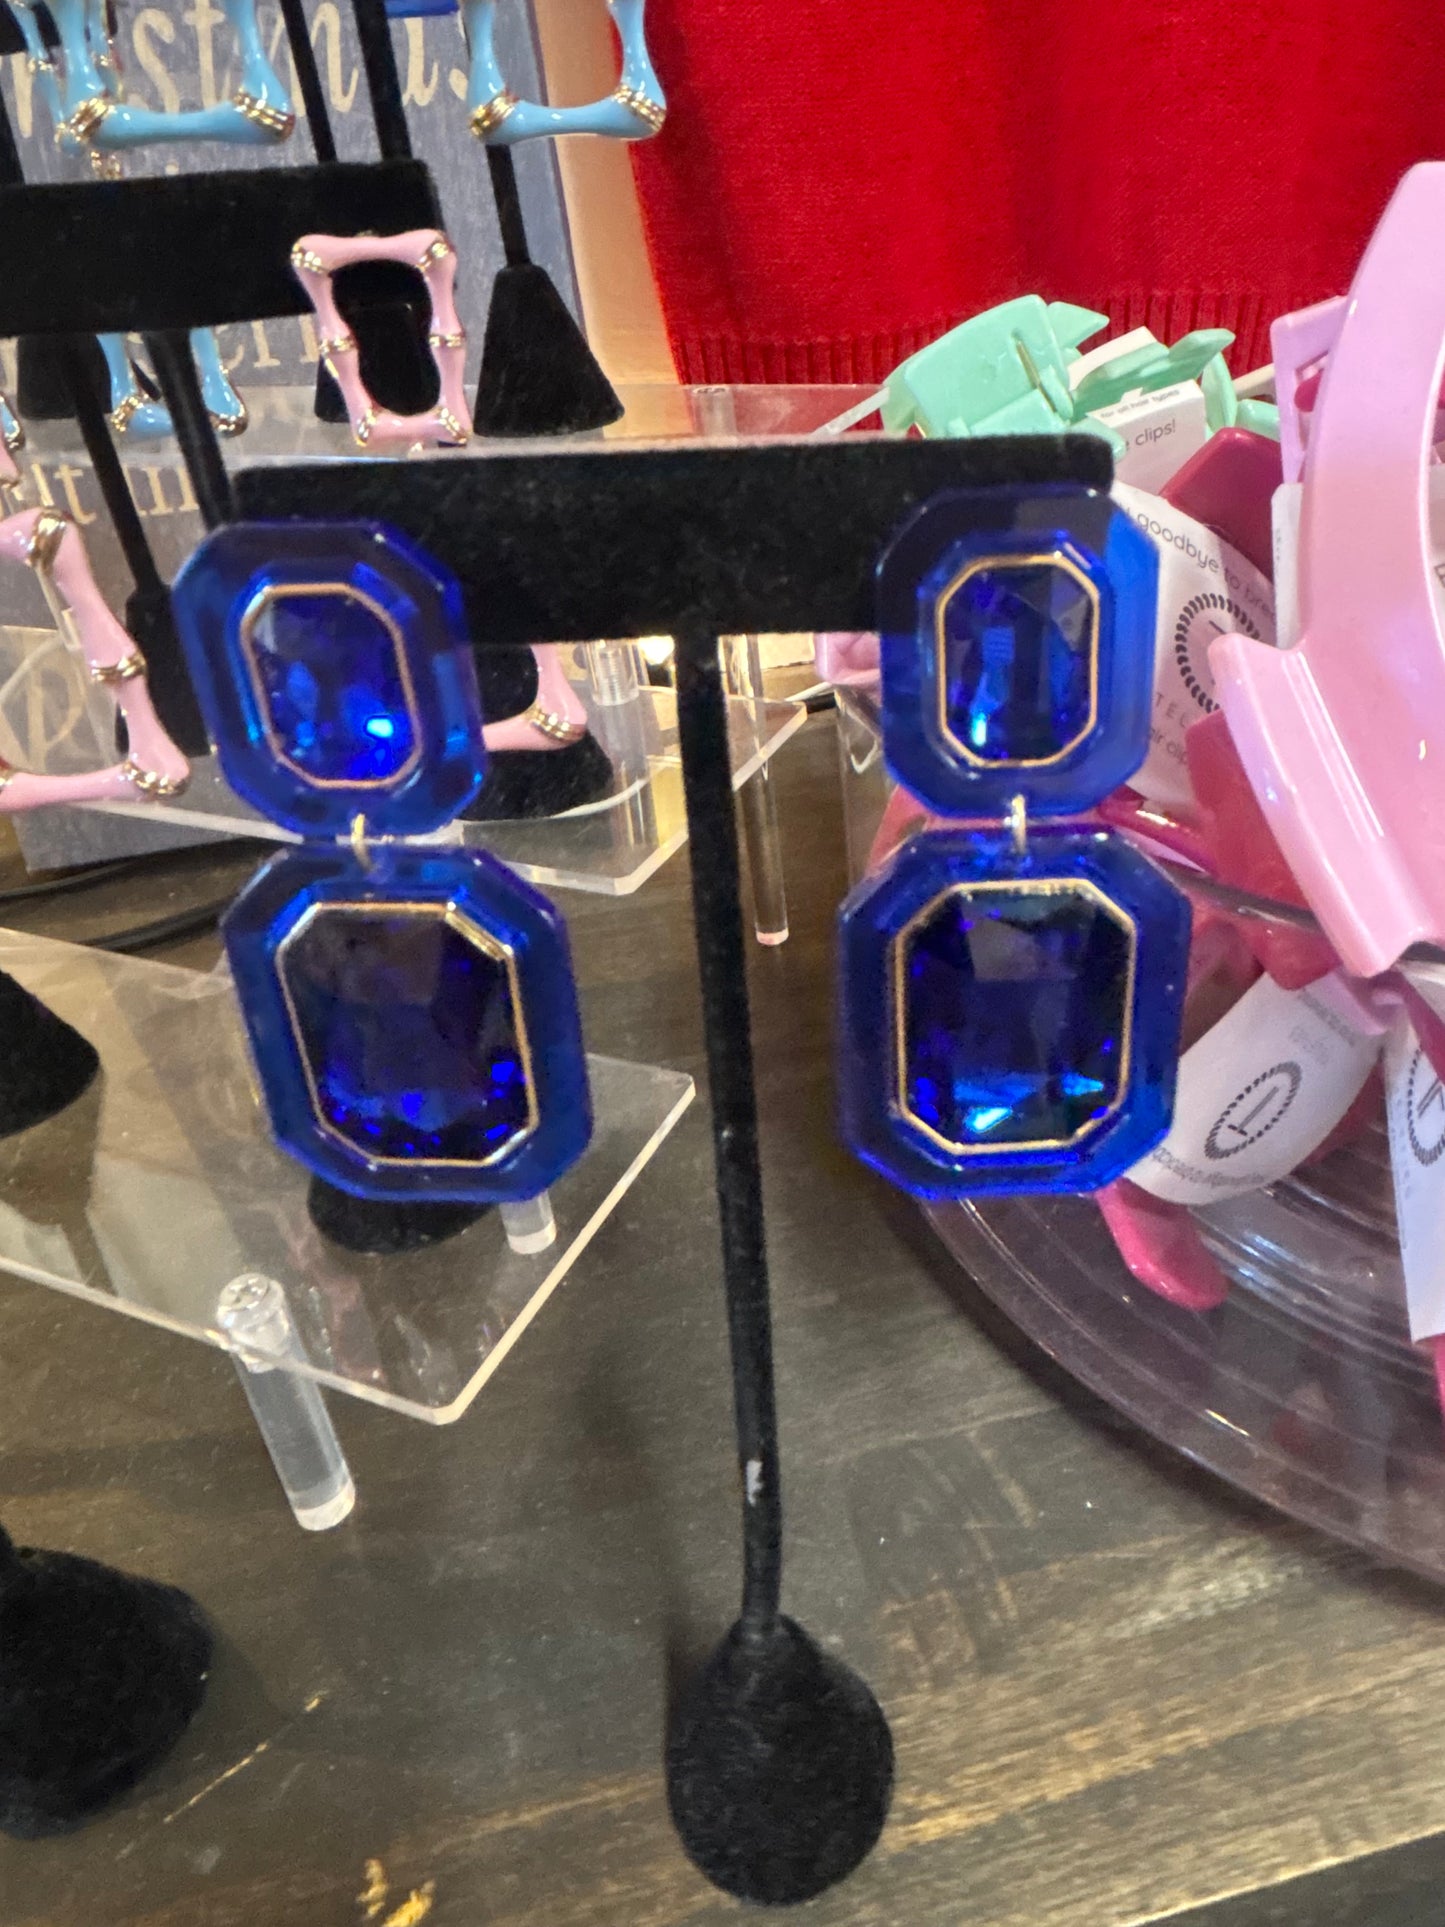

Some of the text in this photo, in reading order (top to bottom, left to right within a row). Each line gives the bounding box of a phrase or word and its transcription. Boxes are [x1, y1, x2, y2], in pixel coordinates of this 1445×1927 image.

[1151, 389, 1180, 402] types
[1135, 418, 1176, 446] clips!
[1137, 513, 1220, 573] goodbye
[1224, 567, 1240, 590] to
